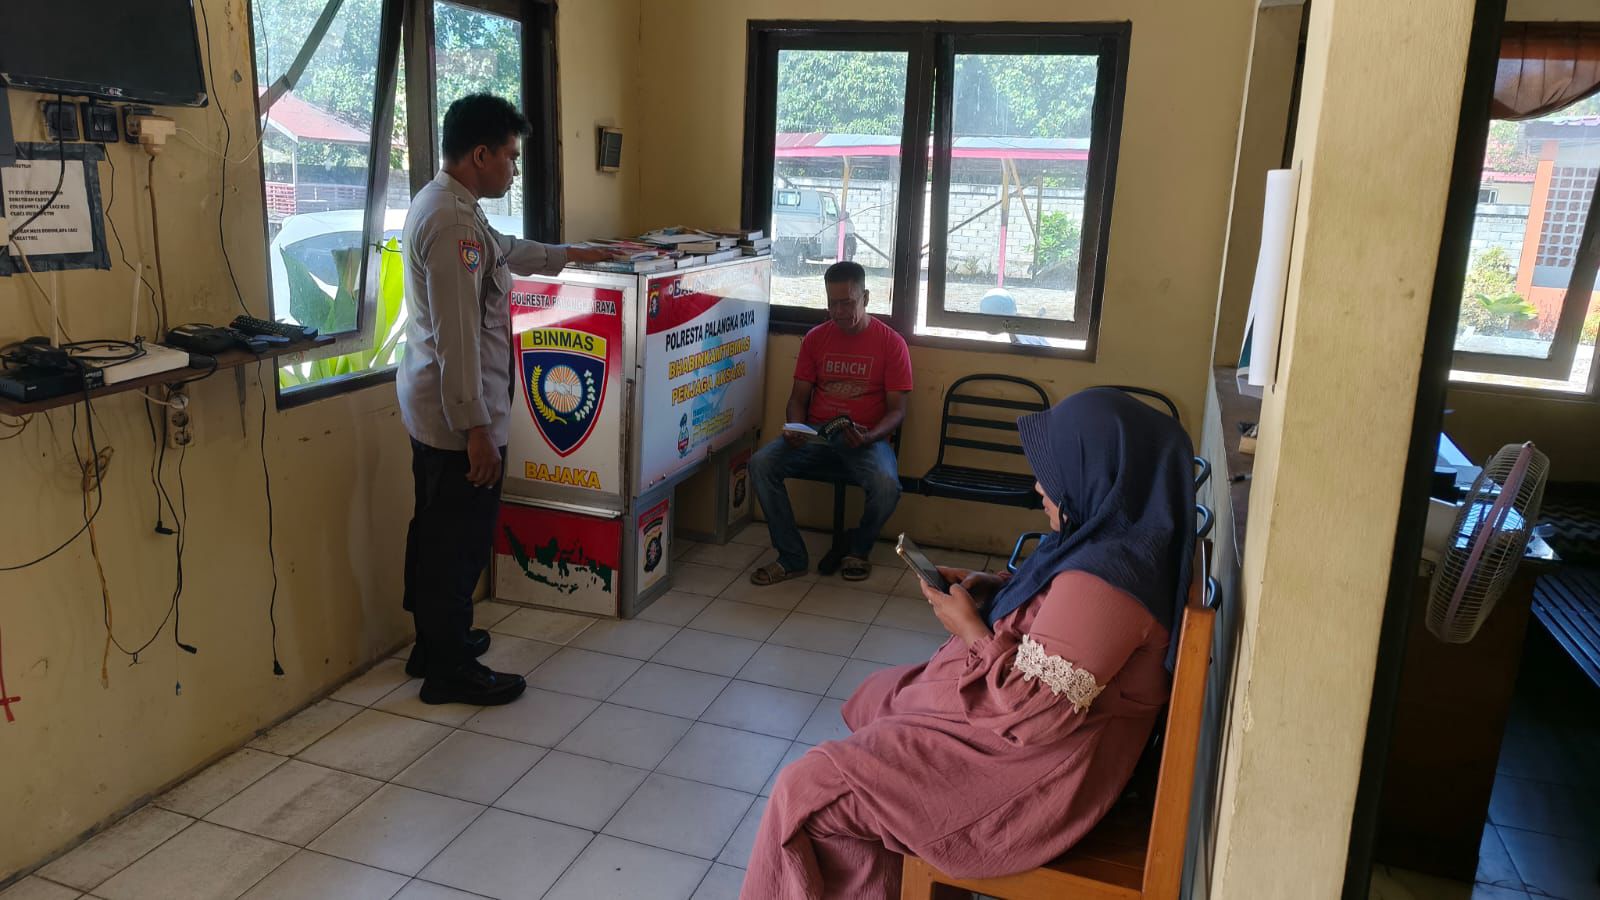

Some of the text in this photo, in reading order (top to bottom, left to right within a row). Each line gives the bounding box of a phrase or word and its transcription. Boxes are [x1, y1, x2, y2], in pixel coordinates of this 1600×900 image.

[511, 291, 550, 309] POLRESTA
[595, 299, 617, 315] RAYA
[532, 330, 594, 351] BINMAS
[665, 309, 755, 352] POLRESTA PALANGKA RAYA
[826, 360, 867, 376] BENCH
[671, 374, 713, 406] PENJAGA
[524, 460, 601, 490] BAJAKA
